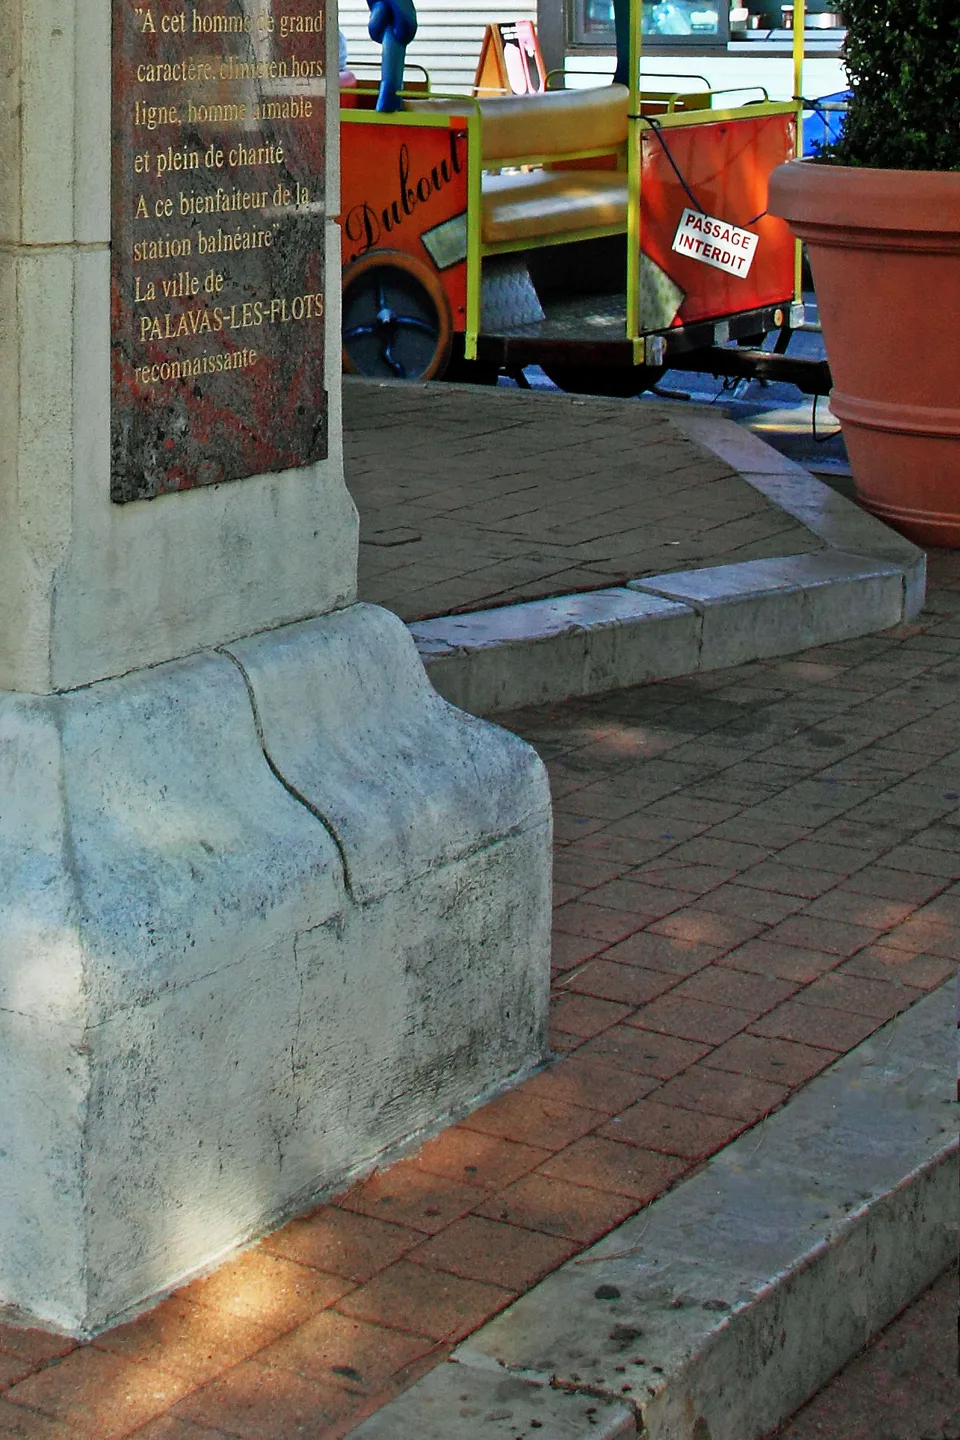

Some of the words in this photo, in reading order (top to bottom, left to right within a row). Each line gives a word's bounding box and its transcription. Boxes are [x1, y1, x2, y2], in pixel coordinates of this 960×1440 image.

[161, 11, 186, 33] cet
[192, 9, 252, 33] homme
[257, 8, 275, 33] de
[280, 10, 323, 37] grand
[291, 55, 323, 78] hors
[134, 100, 182, 130] ligne,
[189, 100, 247, 124] homme
[253, 95, 313, 121] aimable
[134, 150, 150, 173] et
[157, 144, 199, 177] plein
[204, 144, 224, 168] de
[134, 194, 149, 220] A
[155, 198, 173, 218] ce
[180, 184, 268, 216] bienfaiteur
[273, 183, 291, 207] de
[296, 182, 310, 206] la
[134, 232, 191, 262] station
[685, 213, 751, 250] PASSAGE
[678, 233, 746, 270] INTERDIT
[134, 276, 155, 303] La
[162, 271, 200, 298] ville
[205, 268, 224, 292] de
[140, 293, 324, 342] PALAVAS-LES-FLOTS
[134, 347, 257, 385] reconnaissante
